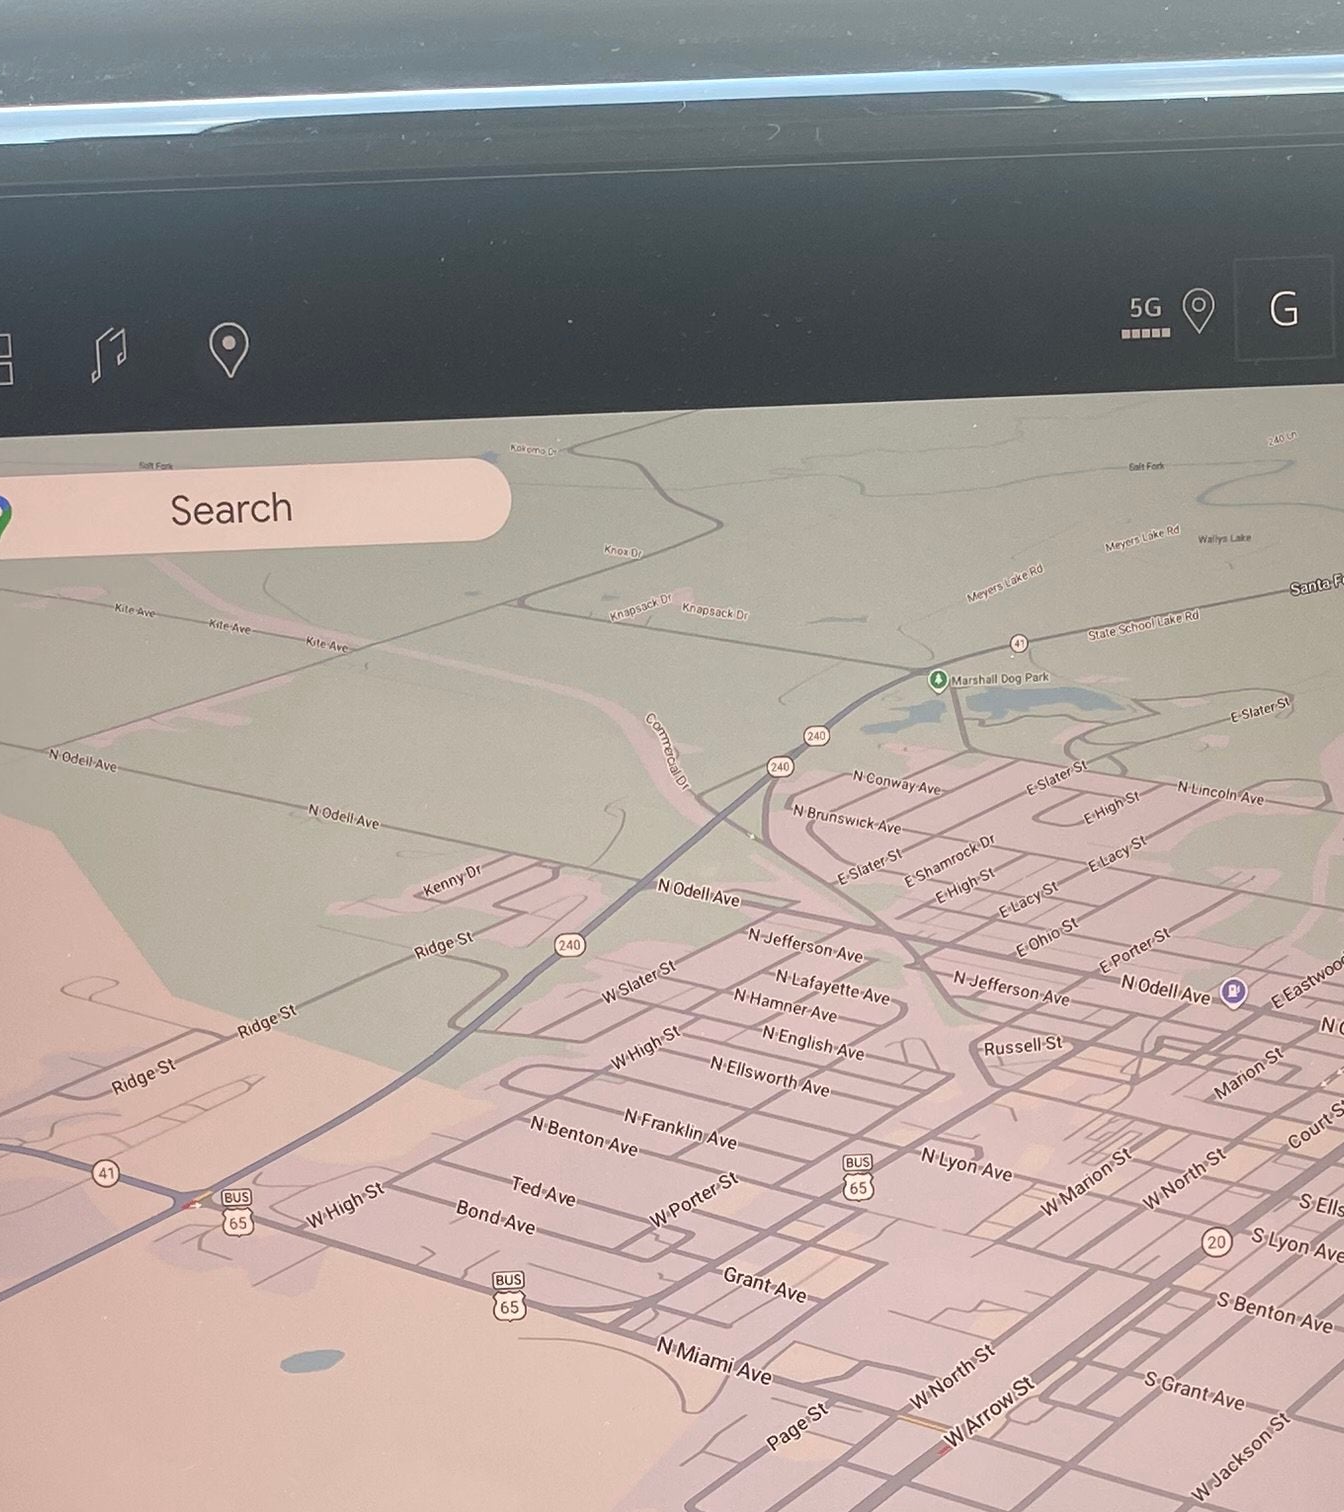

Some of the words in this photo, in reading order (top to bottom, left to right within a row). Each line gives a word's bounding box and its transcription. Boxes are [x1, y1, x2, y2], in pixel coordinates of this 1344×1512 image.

[1130, 298, 1162, 318] 5G
[1269, 291, 1299, 326] G
[171, 492, 292, 525] Search
[967, 583, 1001, 603] Meyers
[1003, 571, 1030, 591] Lake
[1030, 563, 1043, 576] Rd
[1290, 580, 1330, 597] Santa
[682, 602, 734, 619] Knapsack
[736, 609, 748, 621] Dr
[306, 635, 325, 648] Kite
[326, 641, 348, 653] Ave
[952, 673, 998, 686] Marshall
[1001, 673, 1022, 685] Dog
[1025, 671, 1049, 683] Park
[807, 731, 825, 741] 240
[771, 763, 789, 772] 240
[1177, 781, 1189, 793] N
[1191, 784, 1237, 801] Lincoln
[1240, 790, 1265, 806] Ave
[308, 804, 320, 817] N
[322, 807, 354, 825] Odell
[355, 815, 380, 830] Ave
[793, 805, 804, 818] N
[807, 807, 874, 829] Brunswick
[875, 818, 902, 835] Ave
[423, 875, 464, 897] Kenny
[466, 864, 482, 879] Dr
[837, 872, 847, 886] E
[847, 857, 884, 881] Slater
[884, 848, 903, 862] St
[414, 936, 454, 961] Ridge
[455, 931, 474, 945] St
[559, 939, 580, 951] 240
[775, 969, 787, 983] N
[790, 972, 860, 998] Lafayette
[862, 987, 890, 1005] Ave
[1122, 975, 1135, 990] N
[1138, 978, 1178, 999] Odell
[1179, 988, 1211, 1006] Ave
[984, 1038, 1042, 1056] Russell
[1043, 1036, 1062, 1049] St
[111, 1068, 156, 1096] Ridge
[152, 1057, 176, 1077] St
[710, 1056, 722, 1070] N
[726, 1060, 798, 1089] Ellsworth
[801, 1080, 830, 1098] Ave
[1214, 1062, 1265, 1101] Marion
[1264, 1047, 1284, 1066] St
[1288, 1112, 1334, 1150] Court
[98, 1166, 114, 1180] 41
[846, 1157, 870, 1167] BUS
[921, 1148, 936, 1163] N
[938, 1153, 978, 1175] Lyon
[981, 1163, 1014, 1182] Ave
[224, 1191, 248, 1203] BUS
[511, 1176, 542, 1197] Ted
[544, 1187, 576, 1207] Ave
[850, 1181, 867, 1194] 65
[306, 1213, 324, 1229] W
[324, 1193, 365, 1222] High
[365, 1182, 385, 1199] St
[456, 1200, 502, 1225] Bond
[504, 1217, 536, 1235] Ave
[229, 1217, 247, 1230] 65
[1208, 1236, 1226, 1249] 20
[496, 1274, 521, 1285] BUS
[723, 1267, 772, 1294] Grant
[774, 1282, 807, 1303] Ave
[501, 1300, 519, 1314] 65
[1217, 1292, 1231, 1308] S
[1234, 1295, 1296, 1325] Benton
[1300, 1313, 1334, 1334] Ave
[657, 1336, 674, 1354] N
[675, 1342, 735, 1374] Miami
[737, 1365, 772, 1386] Ave
[767, 1418, 808, 1452] Page
[806, 1402, 829, 1423] St
